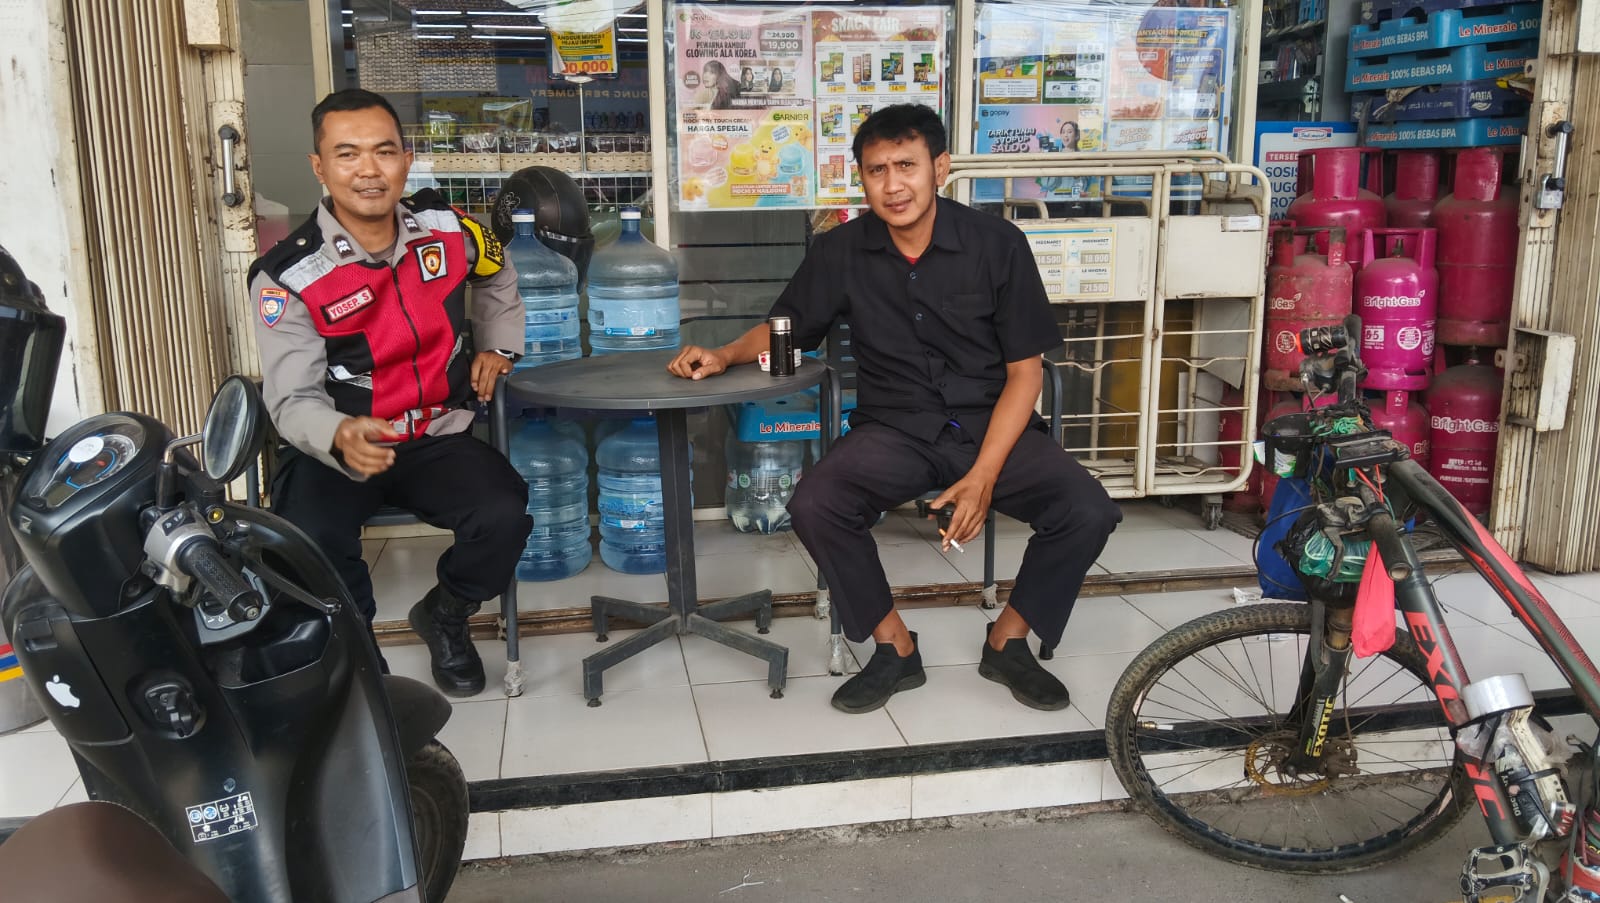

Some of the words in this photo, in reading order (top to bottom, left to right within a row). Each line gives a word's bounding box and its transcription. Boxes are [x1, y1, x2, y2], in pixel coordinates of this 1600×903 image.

[832, 17, 870, 32] SNACK
[875, 16, 900, 32] FAIR
[1459, 26, 1471, 37] Le
[1473, 21, 1517, 36] Minerale
[1382, 35, 1396, 46] 100%
[1396, 32, 1416, 44] BEBAS
[1416, 30, 1429, 41] BPA
[686, 48, 719, 58] GLOWING
[720, 48, 733, 58] ALA
[734, 48, 757, 58] KOREA
[1484, 60, 1495, 71] Le
[1352, 74, 1360, 84] Le
[1361, 71, 1390, 83] Minerale
[1391, 68, 1410, 79] 100%
[1410, 66, 1436, 77] BEBAS
[1436, 63, 1453, 75] BPA
[1469, 91, 1493, 101] AQUA
[772, 113, 809, 121] GARNIER
[989, 109, 1010, 117] gopay
[987, 128, 1009, 138] TARIK
[1399, 130, 1416, 140] 100%
[1417, 129, 1440, 139] BEBAS
[1441, 128, 1456, 138] BPA
[1487, 127, 1498, 137] Le
[991, 143, 1030, 153] SALDO
[361, 292, 370, 302] S
[1277, 297, 1295, 309] Gas
[1364, 296, 1397, 310] Bright
[1398, 296, 1421, 307] Gas
[760, 422, 772, 434] Le
[775, 420, 821, 433] Minerale
[1431, 416, 1471, 433] Bright
[1472, 419, 1499, 433] Gas
[1312, 696, 1335, 758] EXOTIC
